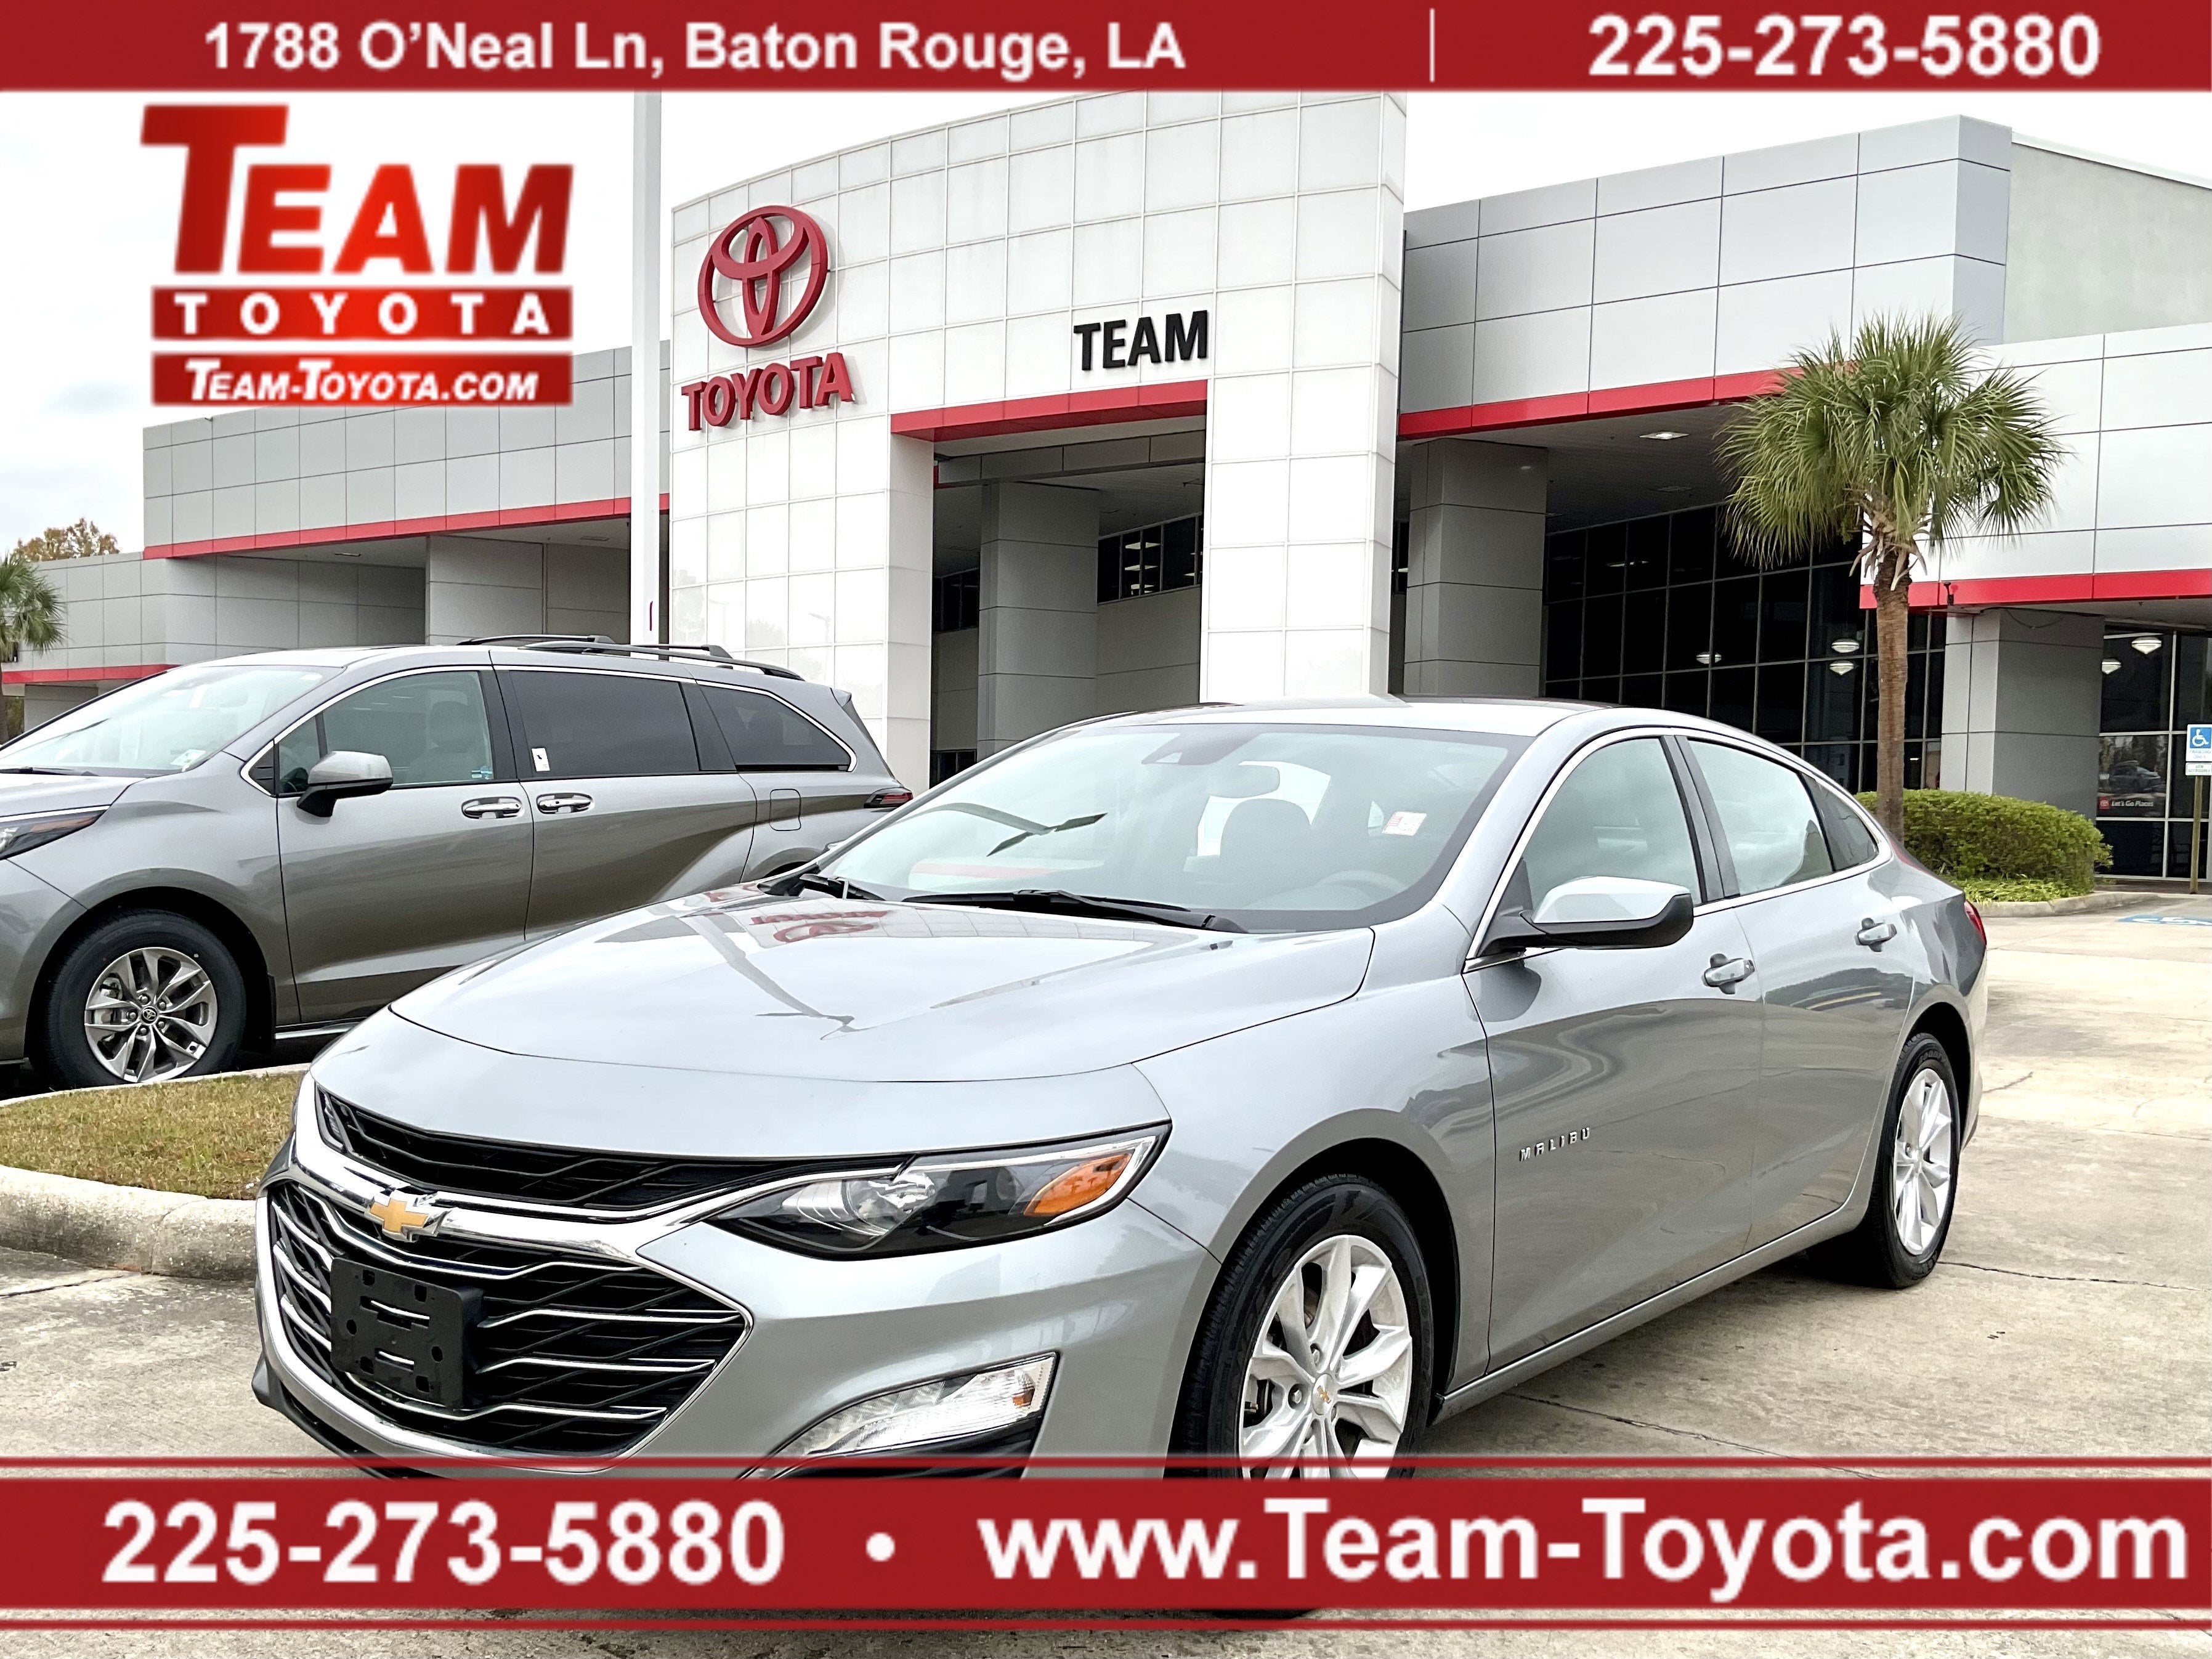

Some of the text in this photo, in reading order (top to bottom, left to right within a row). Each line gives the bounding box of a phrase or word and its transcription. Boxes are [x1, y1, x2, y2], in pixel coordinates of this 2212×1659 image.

[1072, 309, 1209, 371] TEAM
[681, 352, 855, 431] TOYOTA
[1519, 1127, 1590, 1162] MALIBU
